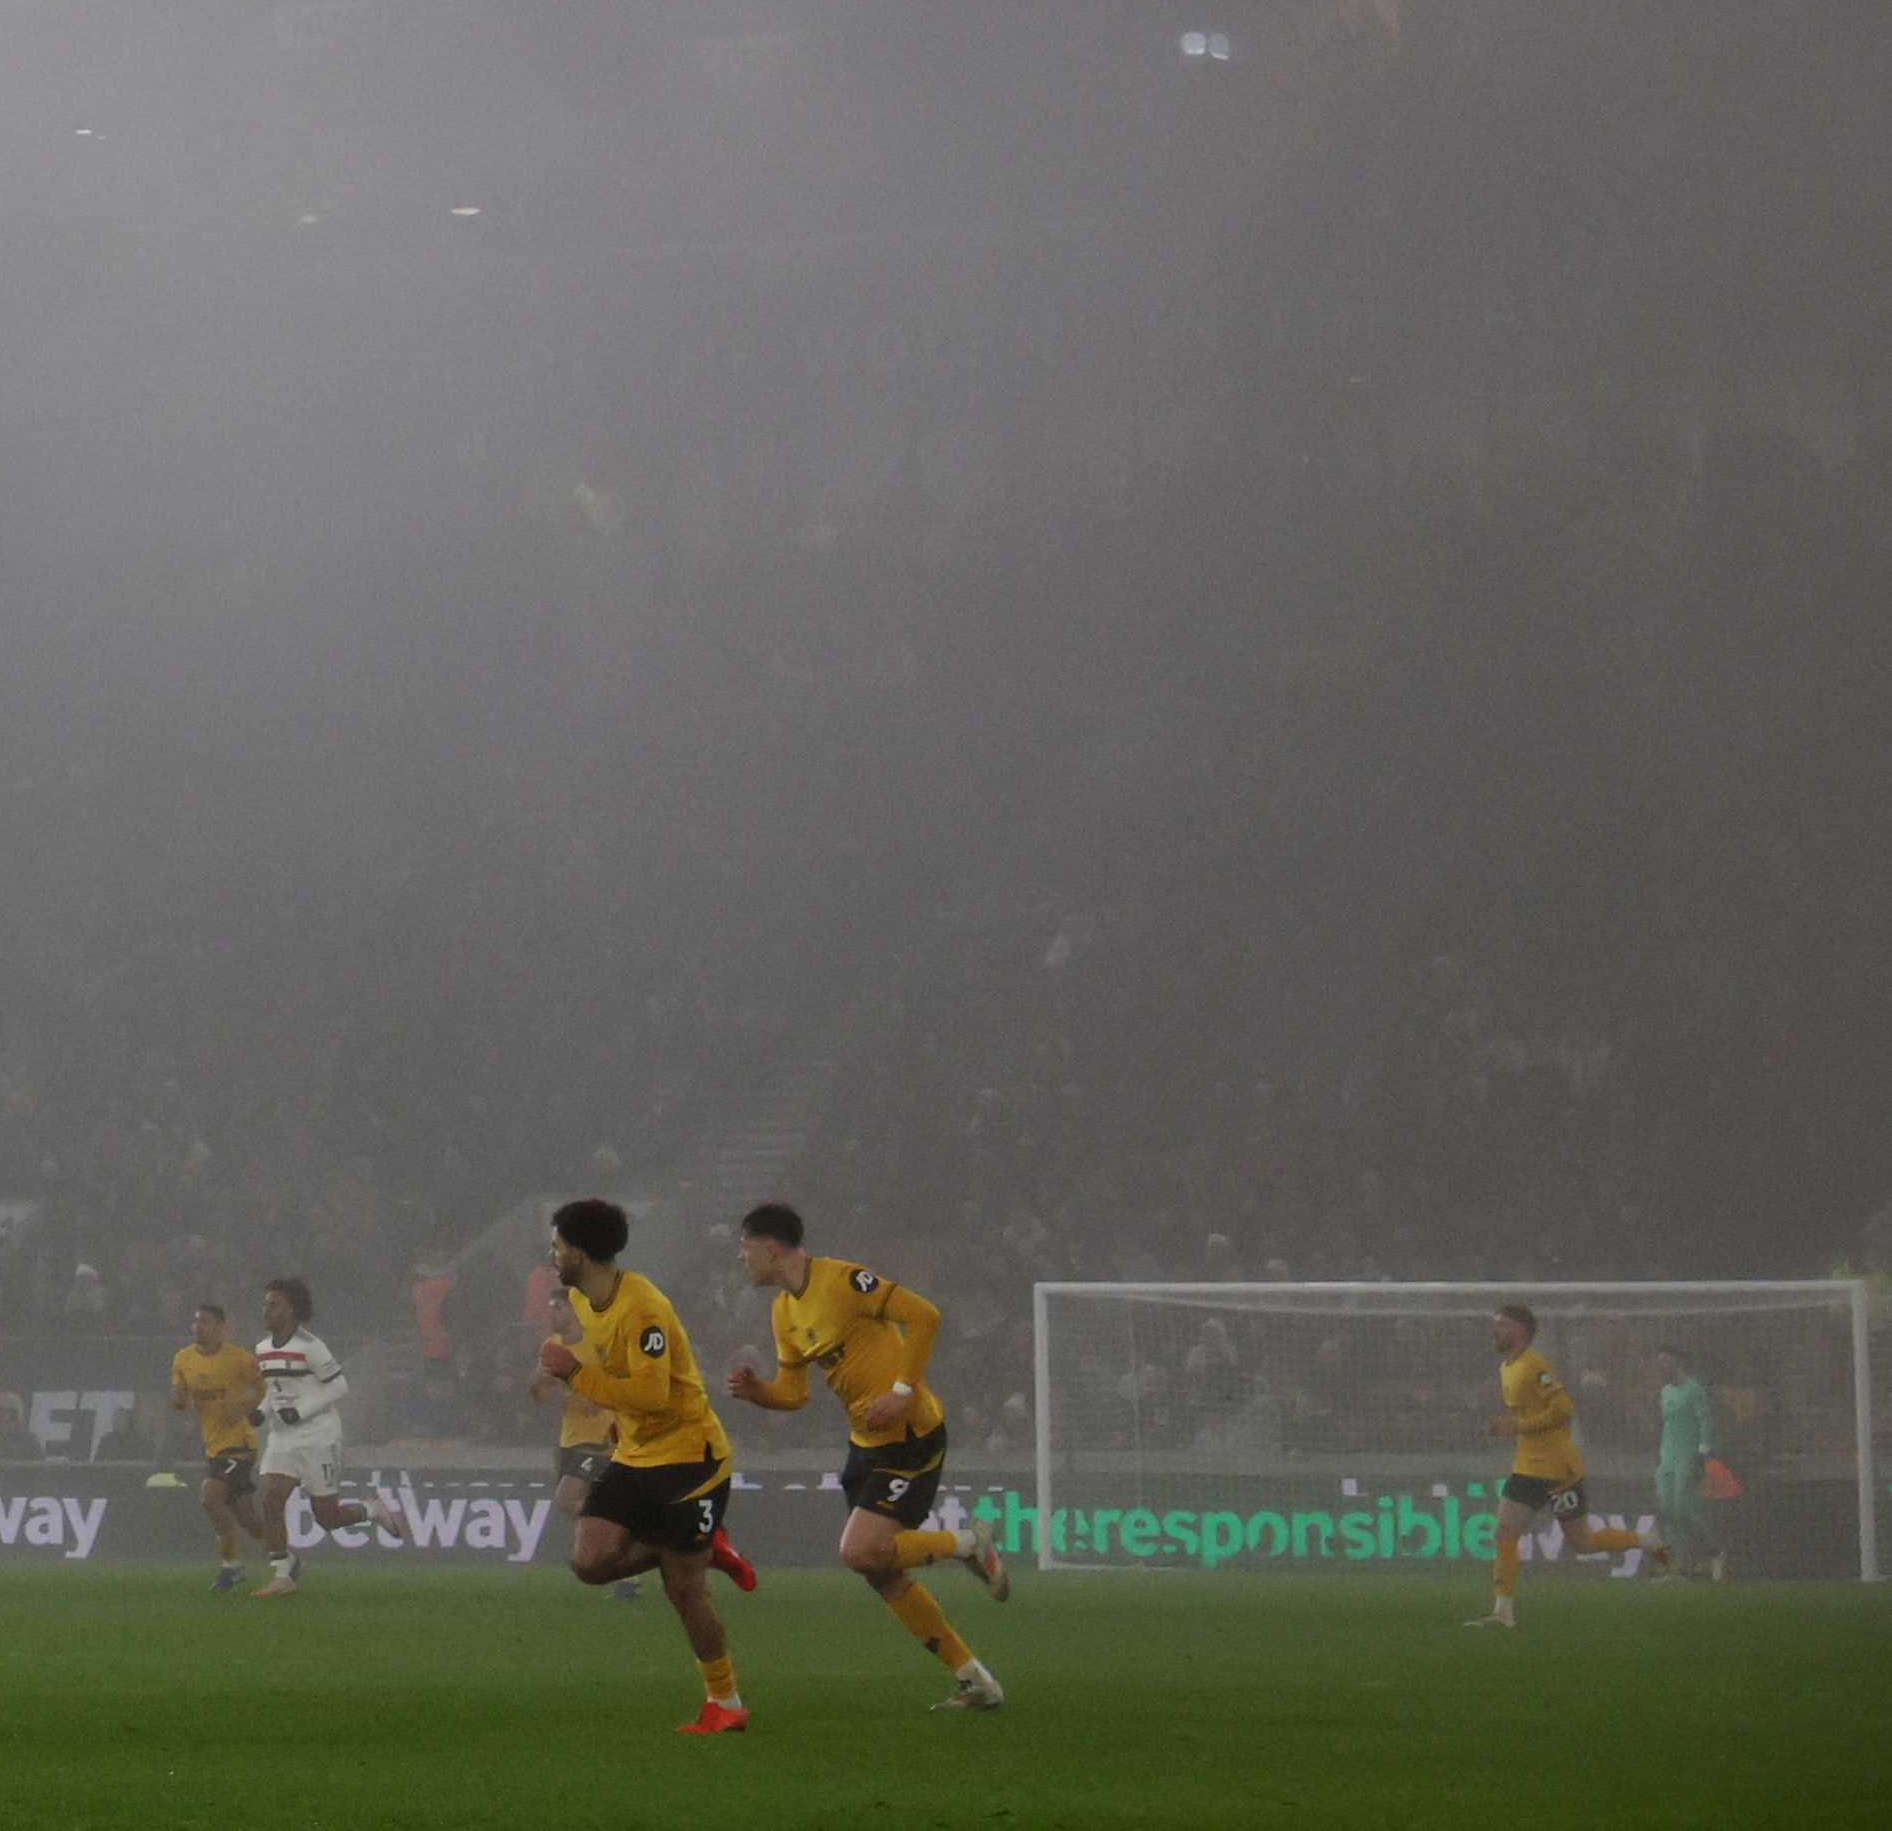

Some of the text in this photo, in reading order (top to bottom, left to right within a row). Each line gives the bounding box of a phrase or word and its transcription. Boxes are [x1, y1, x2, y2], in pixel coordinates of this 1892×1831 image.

[855, 1270, 875, 1293] JD
[644, 1331, 665, 1352] JD
[887, 1478, 910, 1502] 9
[1550, 1489, 1579, 1513] 20
[698, 1499, 713, 1533] 3
